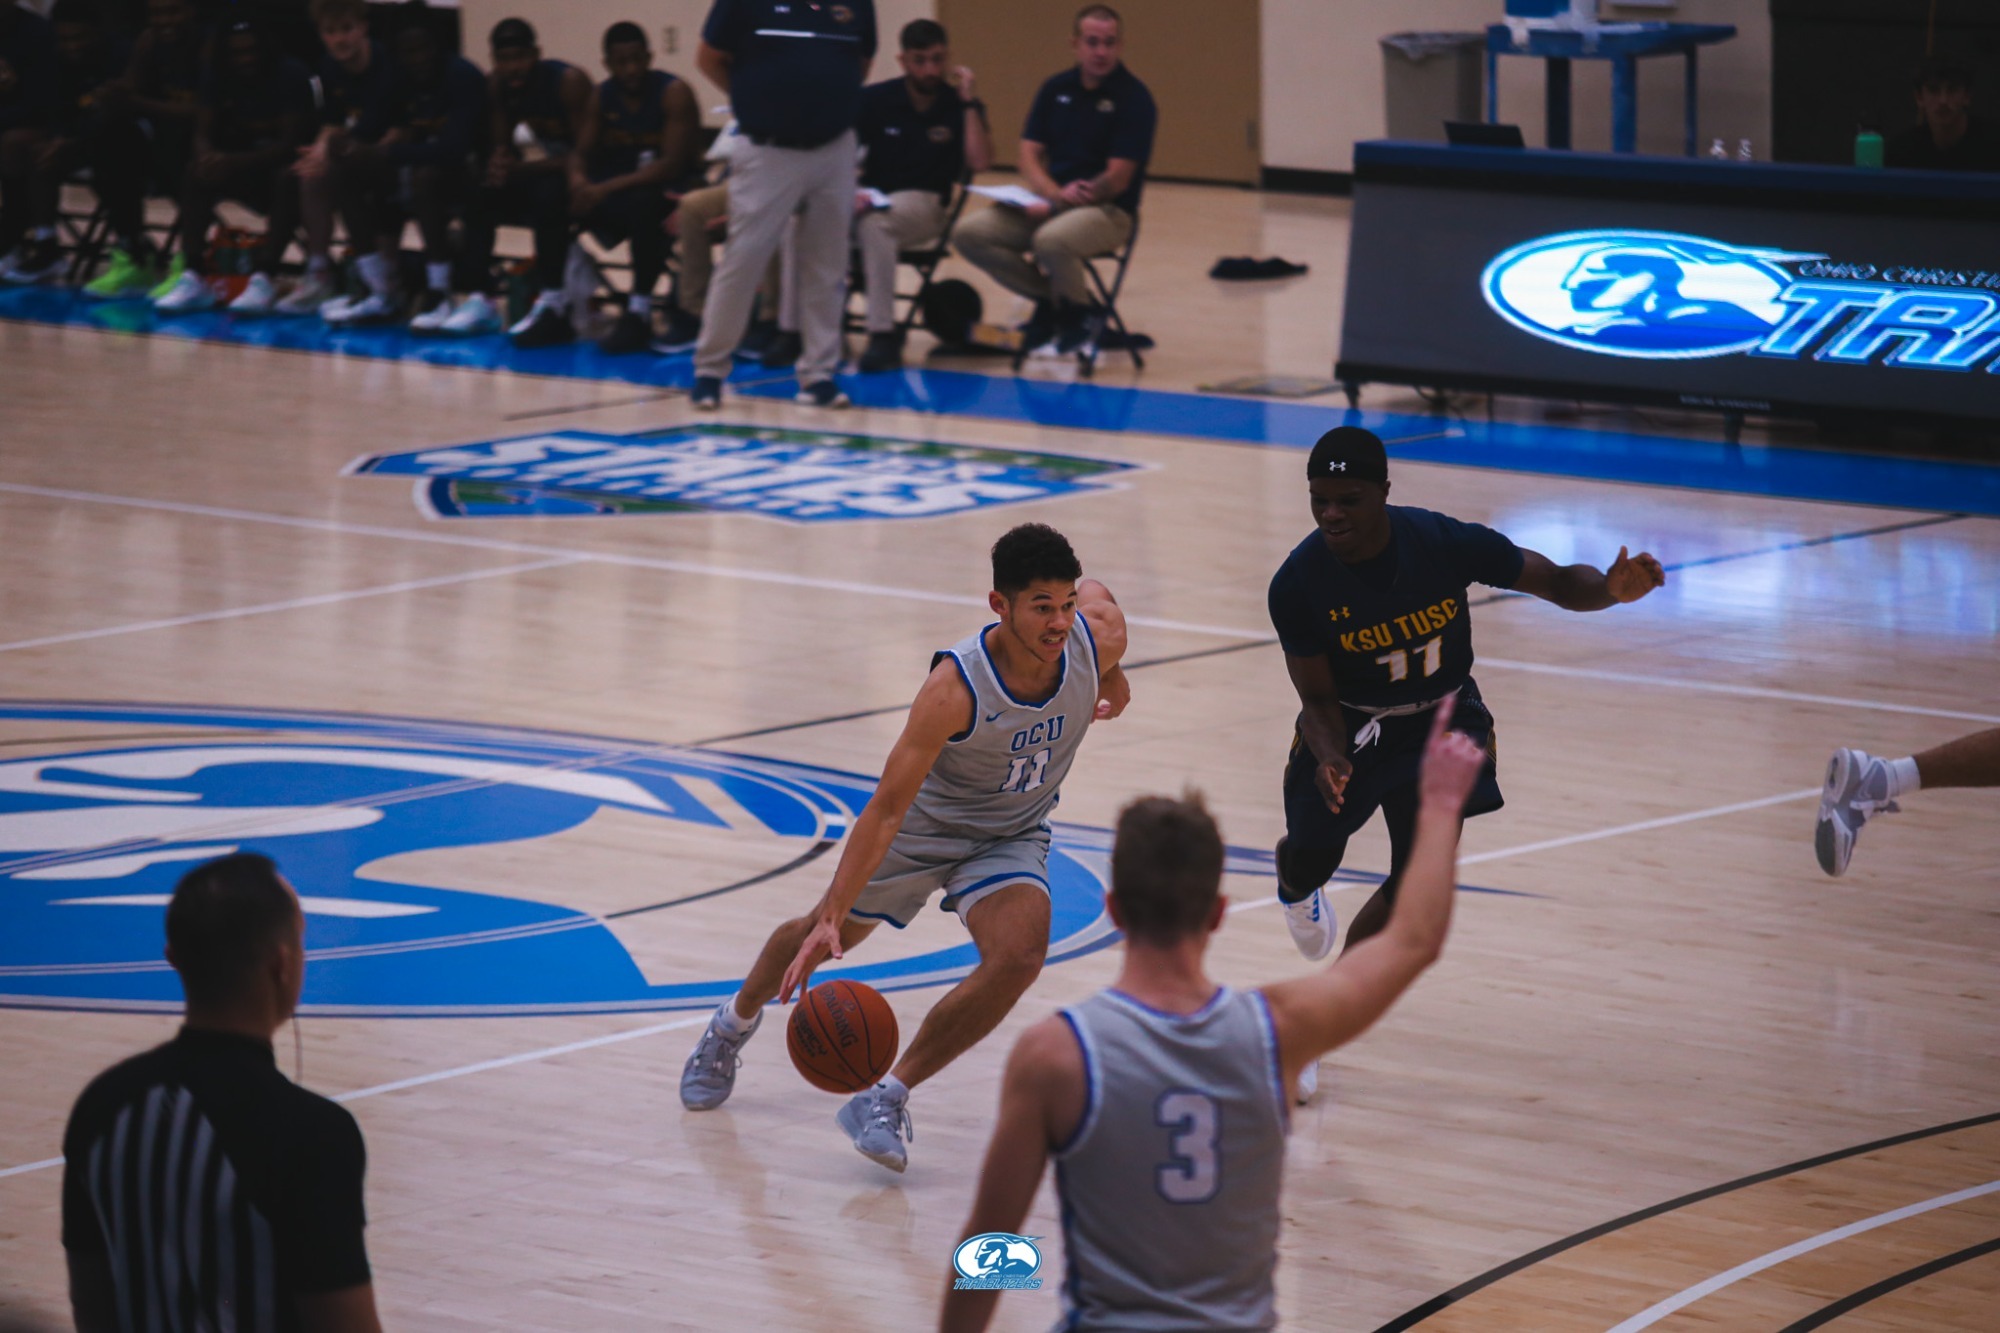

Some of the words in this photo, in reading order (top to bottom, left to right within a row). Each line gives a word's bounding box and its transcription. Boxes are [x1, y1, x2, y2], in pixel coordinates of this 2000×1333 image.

[1340, 622, 1394, 652] KSU
[1393, 598, 1459, 641] TUSC
[1010, 714, 1066, 753] OCU
[999, 747, 1052, 793] 11
[1155, 1087, 1221, 1205] 3
